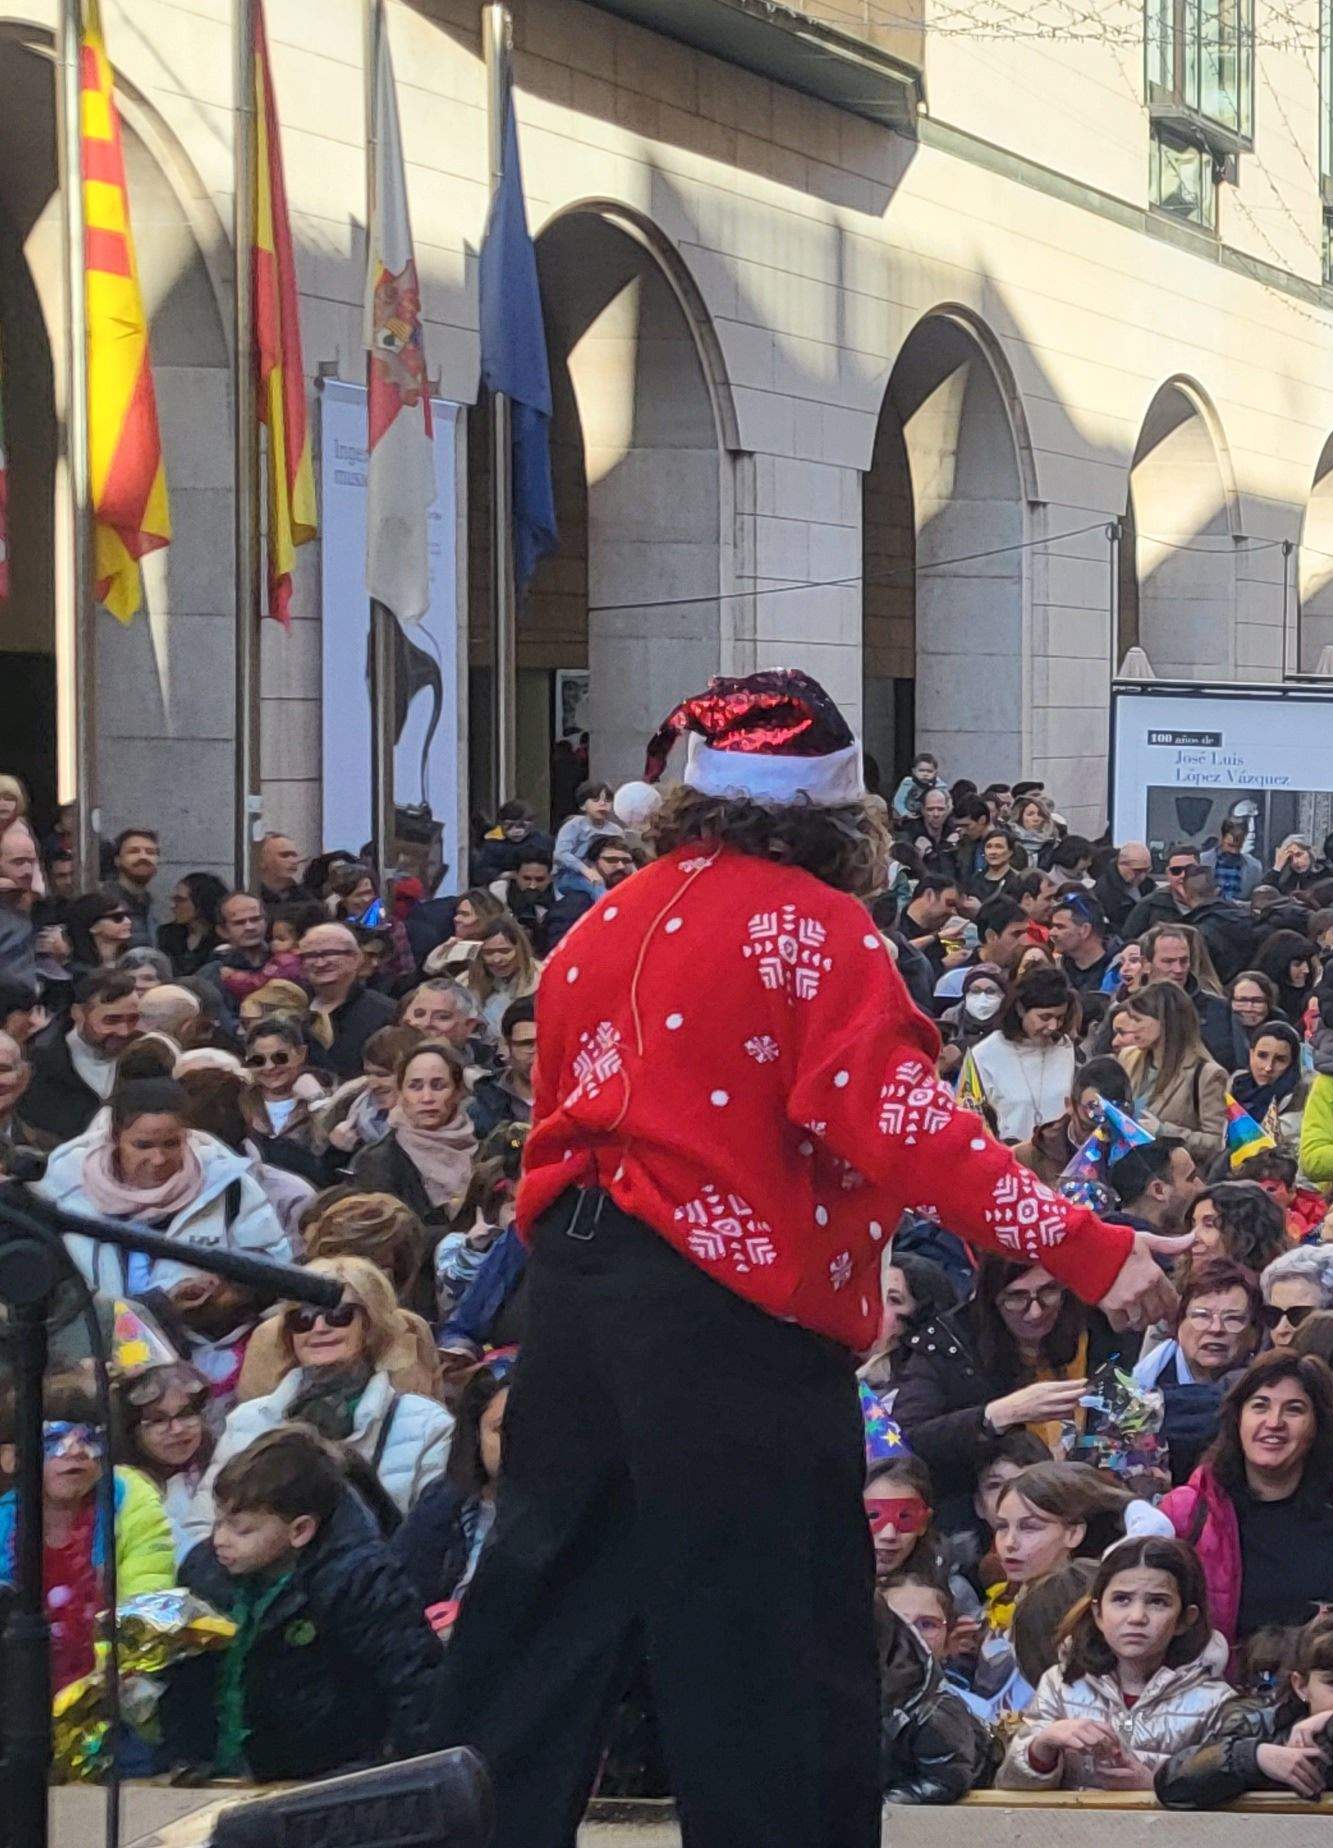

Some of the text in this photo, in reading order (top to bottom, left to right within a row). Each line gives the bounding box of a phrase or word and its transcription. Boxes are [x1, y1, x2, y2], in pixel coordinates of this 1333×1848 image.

[1151, 733, 1215, 745] 100 años de
[1175, 750, 1245, 766] José Luis
[1175, 767, 1290, 788] López Vázquez
